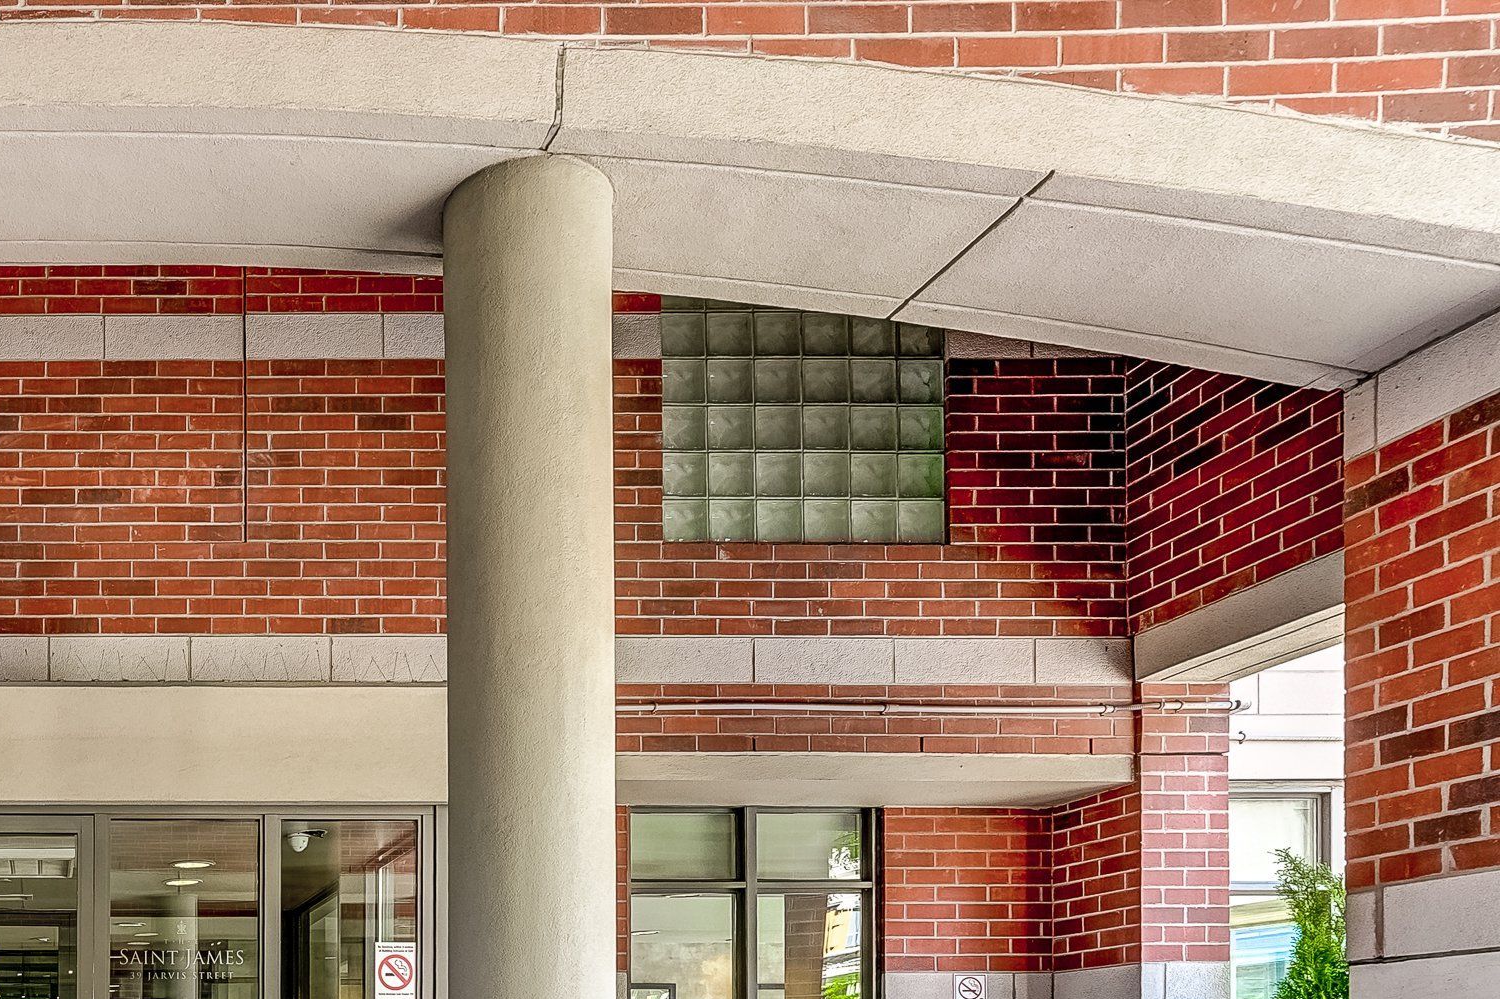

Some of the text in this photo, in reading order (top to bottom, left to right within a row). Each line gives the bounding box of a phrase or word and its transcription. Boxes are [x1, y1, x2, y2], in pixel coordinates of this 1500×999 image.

[120, 949, 244, 970] SAINT JAMES
[148, 972, 186, 981] JARVIS
[193, 972, 234, 980] STREET
